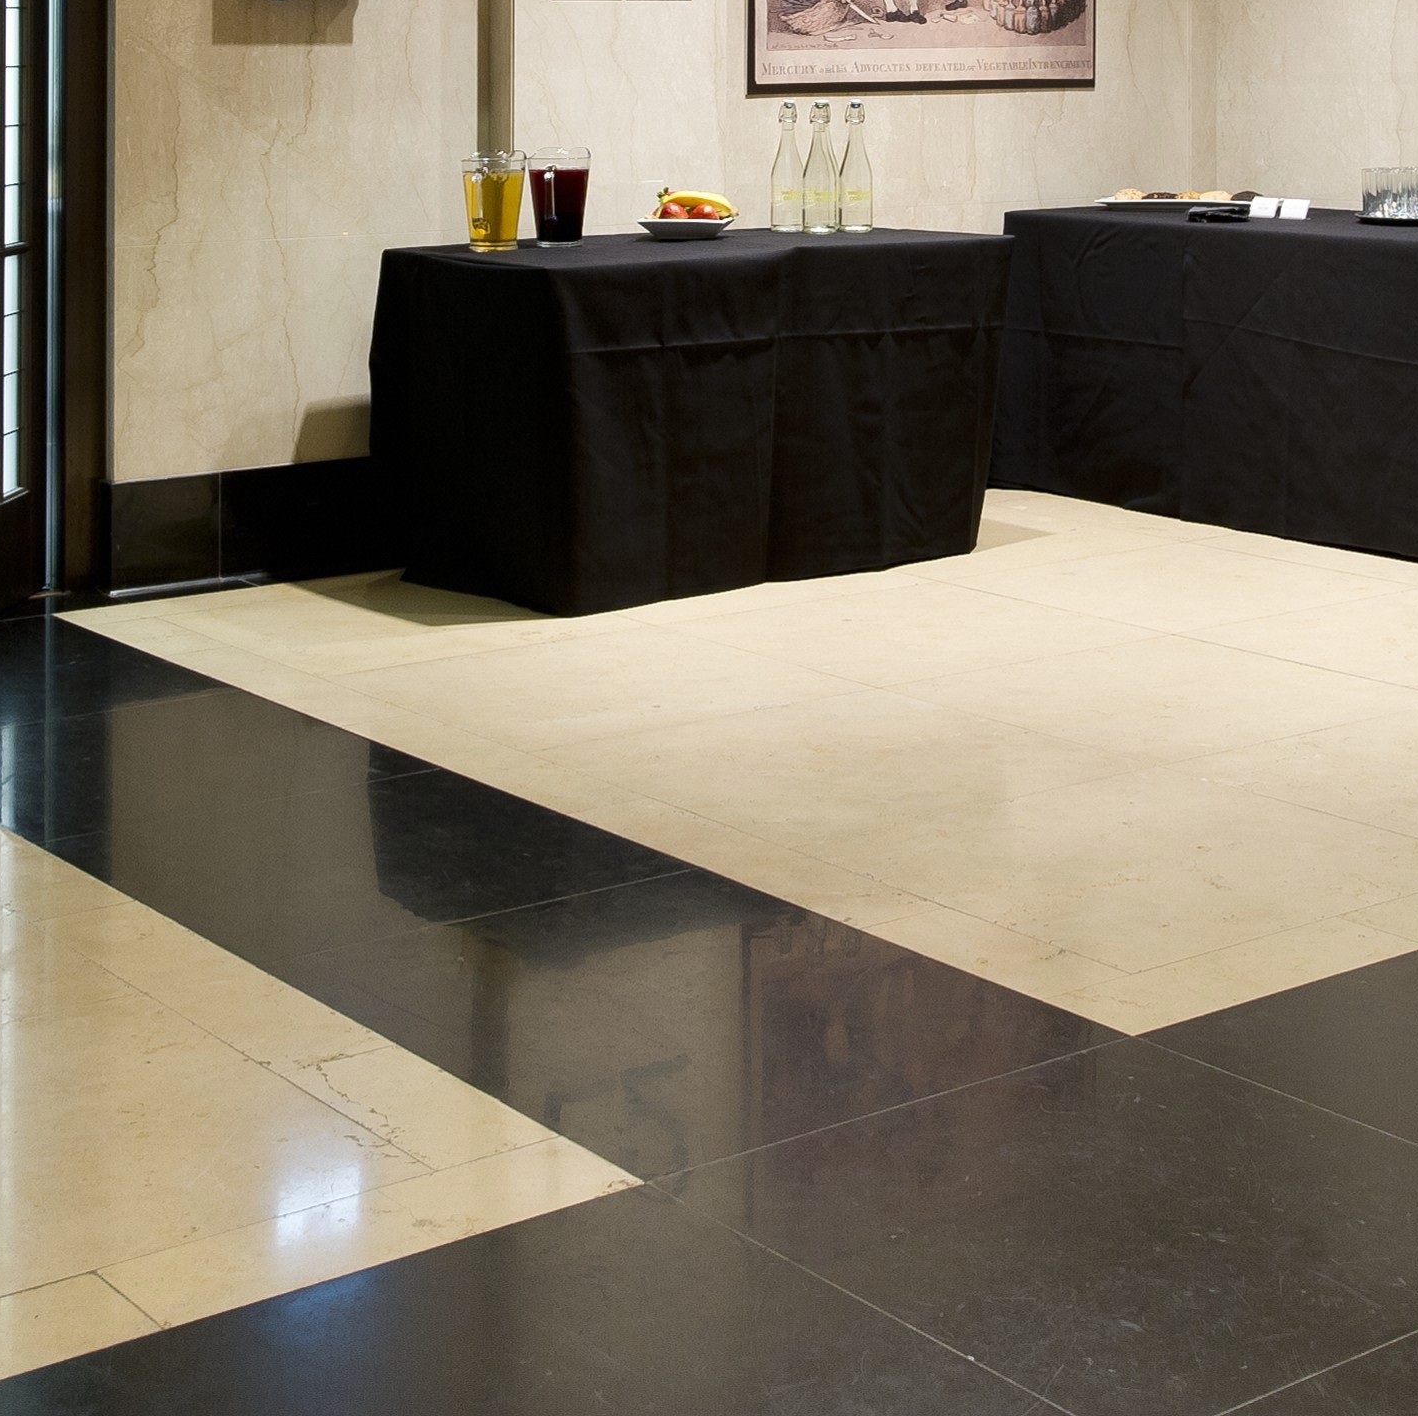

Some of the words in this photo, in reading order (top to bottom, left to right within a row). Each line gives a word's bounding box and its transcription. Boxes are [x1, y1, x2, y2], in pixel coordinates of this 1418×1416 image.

[761, 62, 817, 76] MERCURY
[851, 61, 911, 74] ADVOCATES
[976, 59, 1028, 71] VEGETABLE
